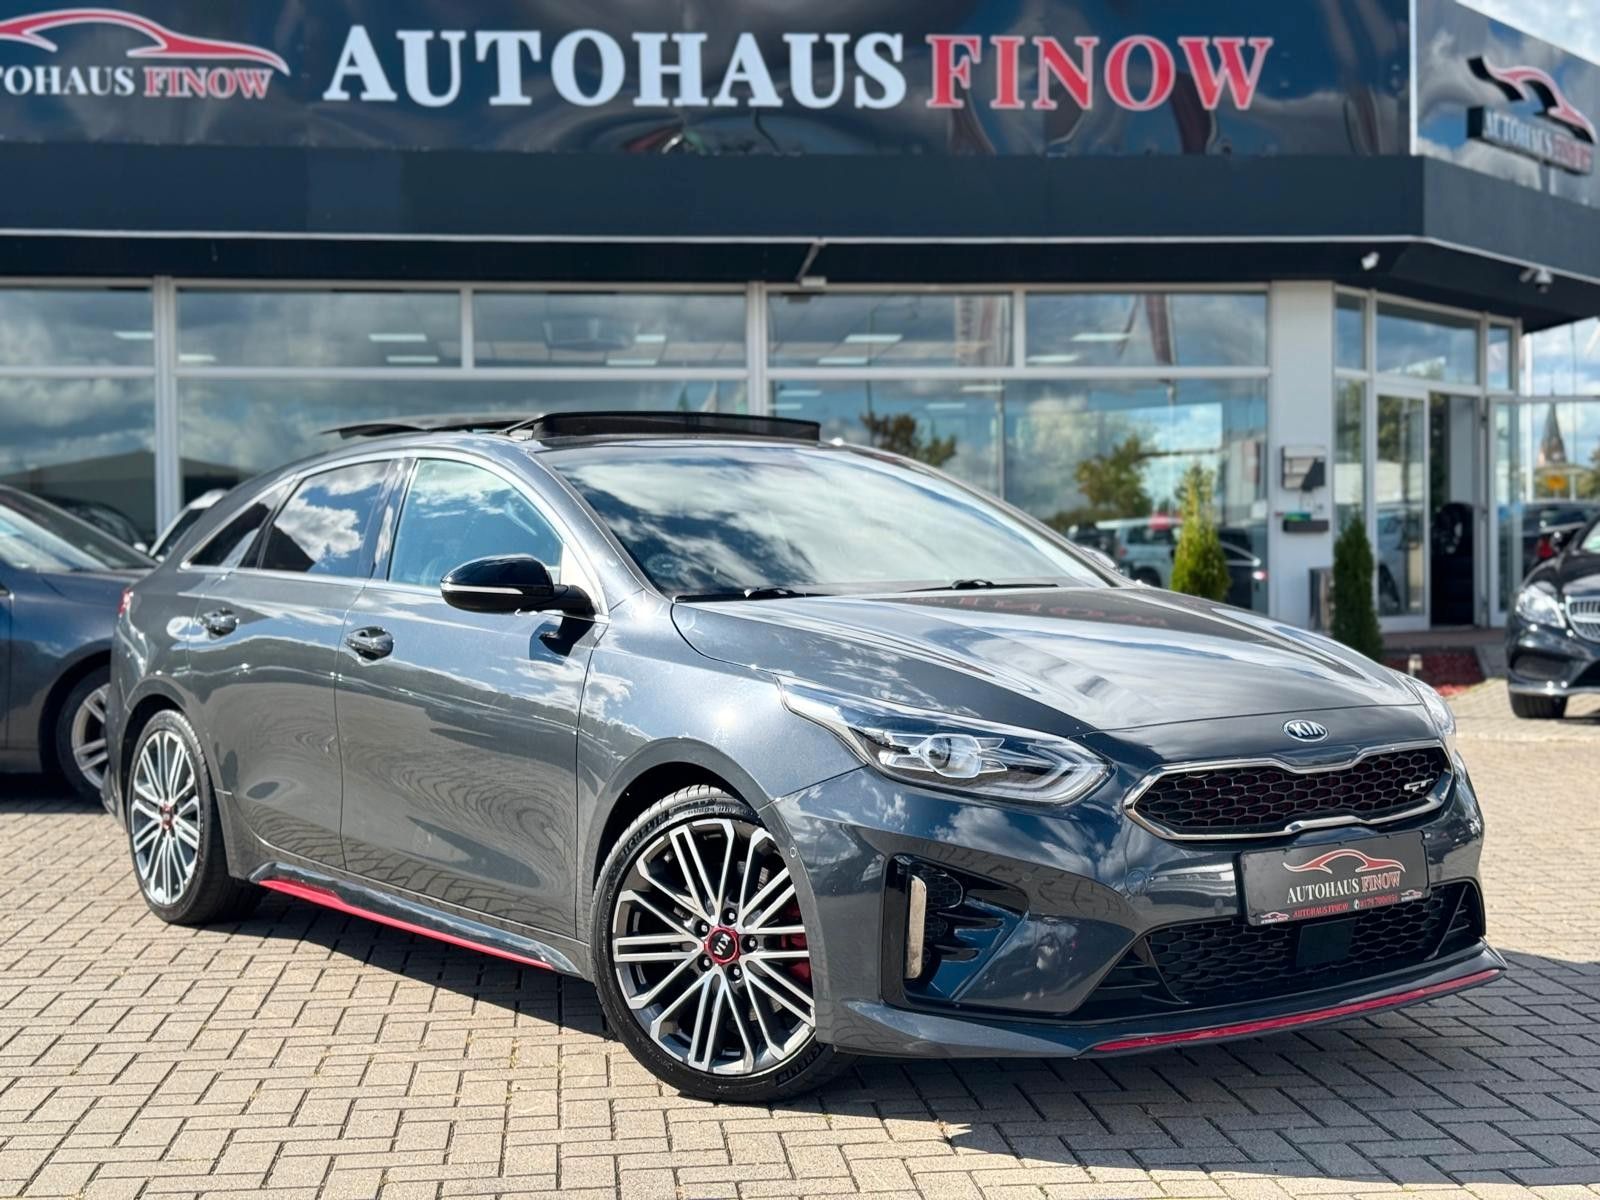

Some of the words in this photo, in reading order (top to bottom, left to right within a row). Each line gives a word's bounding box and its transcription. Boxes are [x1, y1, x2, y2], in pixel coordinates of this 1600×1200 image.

[0, 66, 135, 96] OHAUS
[143, 67, 273, 99] FINOW
[322, 25, 907, 109] AUTOHAUS
[926, 34, 1274, 112] FINOW
[1288, 721, 1327, 738] KIA
[1404, 777, 1434, 792] GT
[1287, 878, 1360, 904] AUTOHAUS
[1361, 870, 1401, 893] FINOW
[714, 933, 731, 956] KIA
